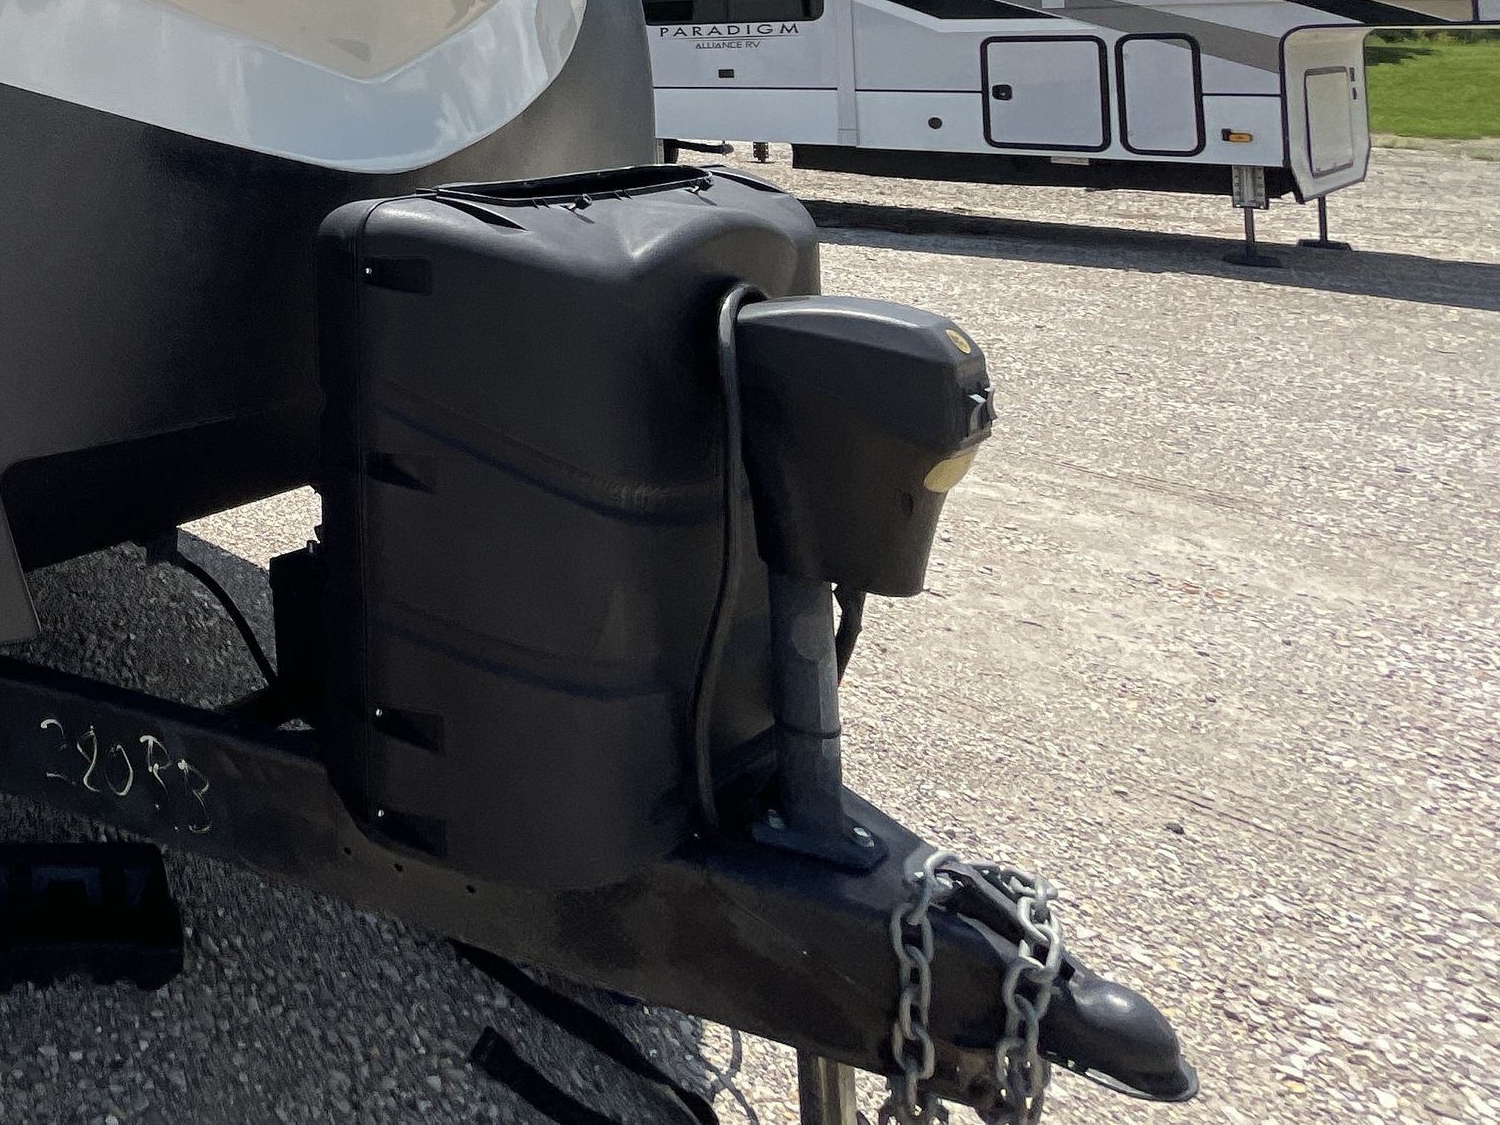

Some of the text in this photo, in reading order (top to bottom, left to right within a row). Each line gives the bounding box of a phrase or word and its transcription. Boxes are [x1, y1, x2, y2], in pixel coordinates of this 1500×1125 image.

[659, 22, 799, 37] PARADIGM
[695, 41, 760, 49] ALLIANCE RV
